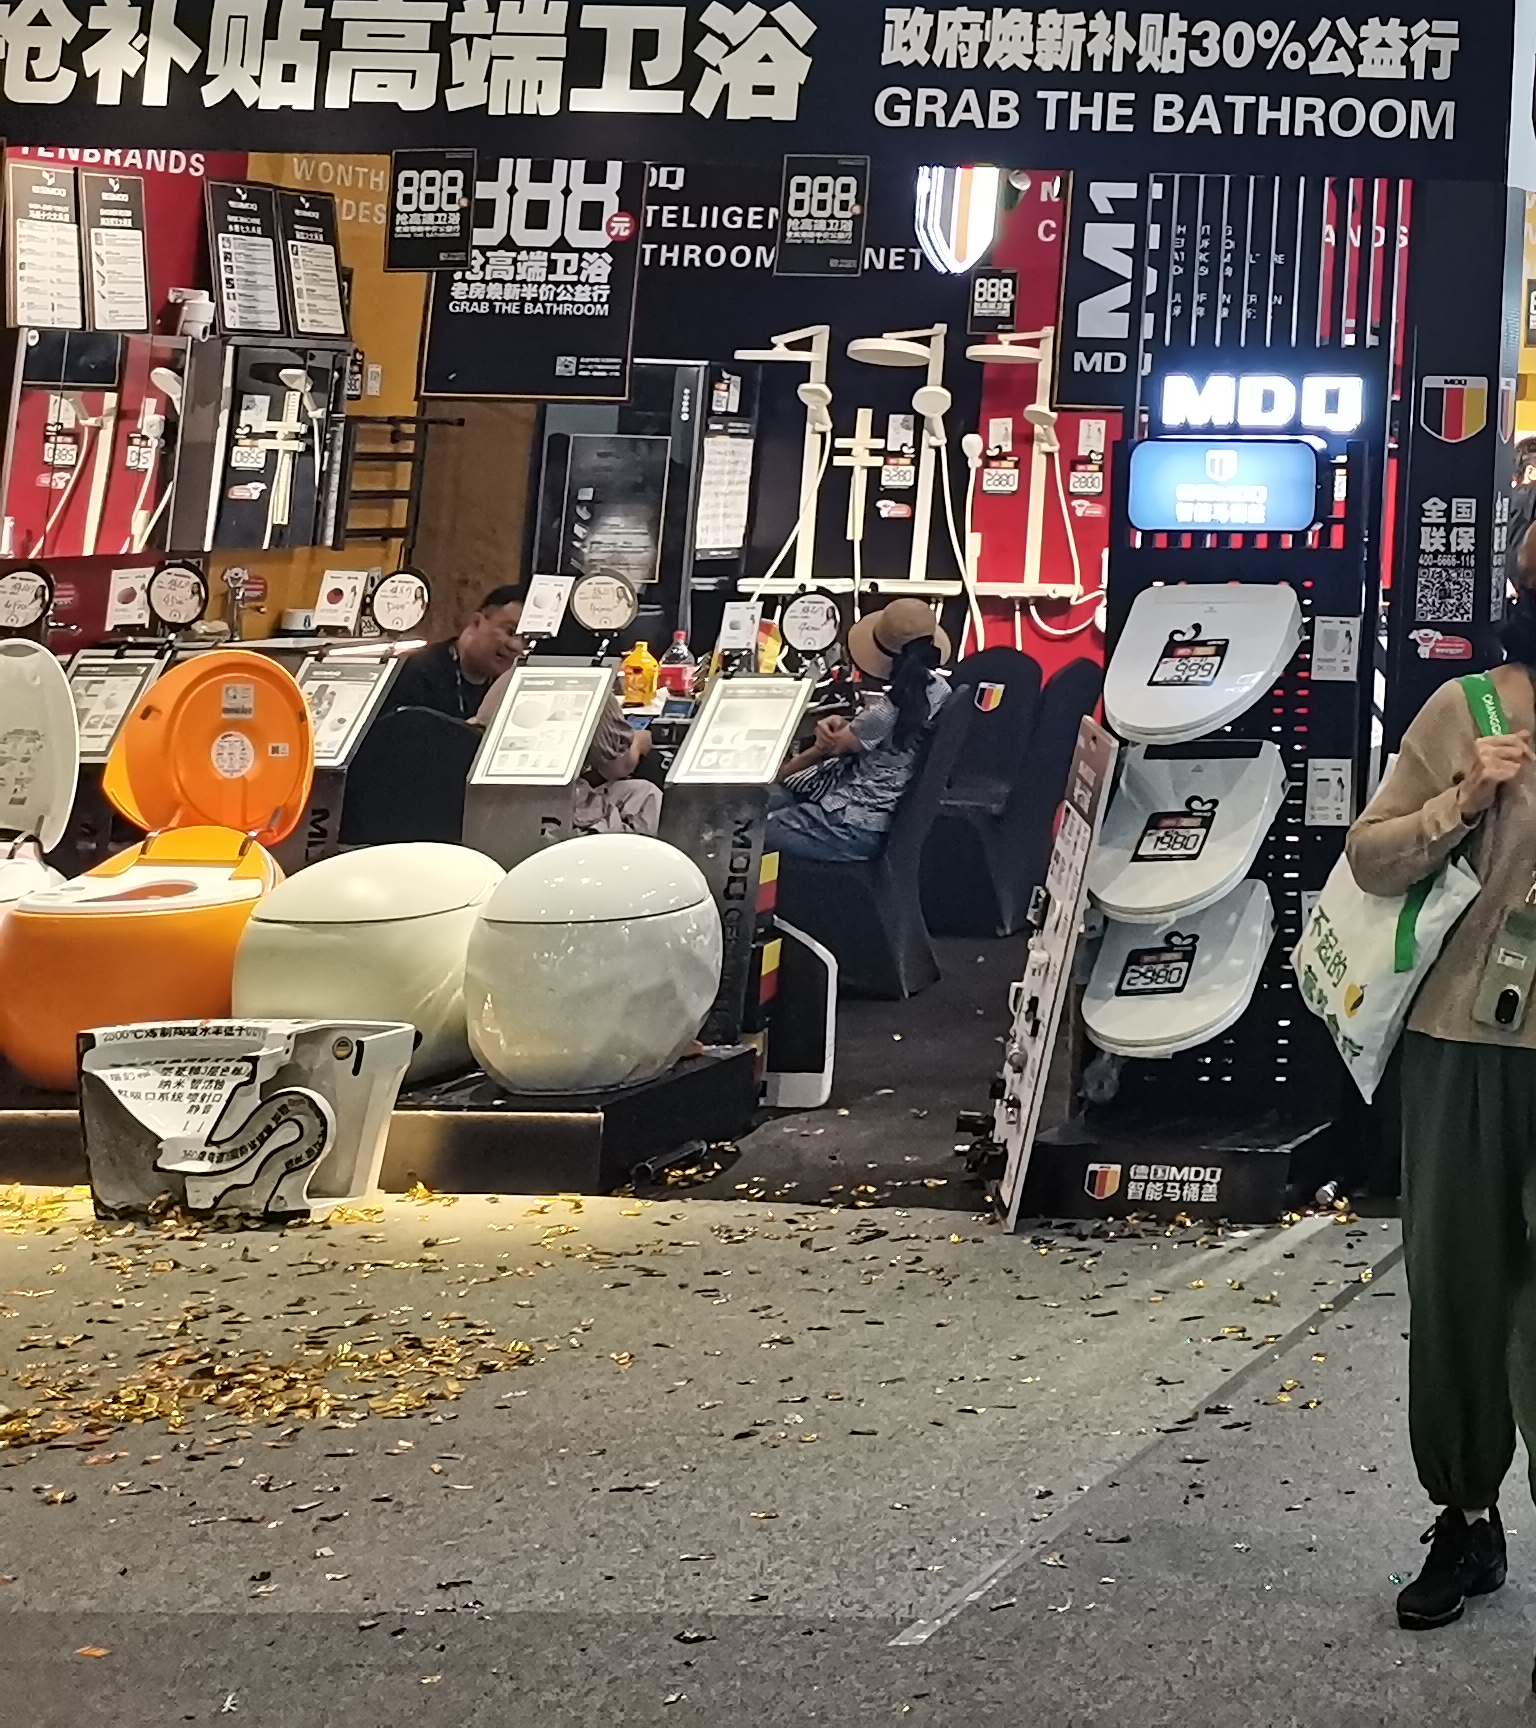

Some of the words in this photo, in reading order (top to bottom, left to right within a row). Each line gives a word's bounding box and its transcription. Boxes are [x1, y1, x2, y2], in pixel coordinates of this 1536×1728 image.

[880, 7, 1460, 82] 政府焕新补贴30%公益行
[873, 86, 1021, 133] GRAB
[1036, 90, 1136, 135] THE
[1152, 93, 1456, 141] BATHROOM
[396, 170, 464, 212] 888
[787, 175, 858, 218] 888
[611, 216, 630, 236] 元
[449, 301, 489, 314] GRAB
[493, 302, 520, 315] THE
[524, 302, 609, 316] BATHROOM
[1161, 374, 1364, 433] MDQ
[1421, 496, 1477, 523] 全国
[1419, 526, 1476, 553] 联保
[1175, 662, 1215, 678] 999
[1127, 1180, 1218, 1203] 智能马桶盖
